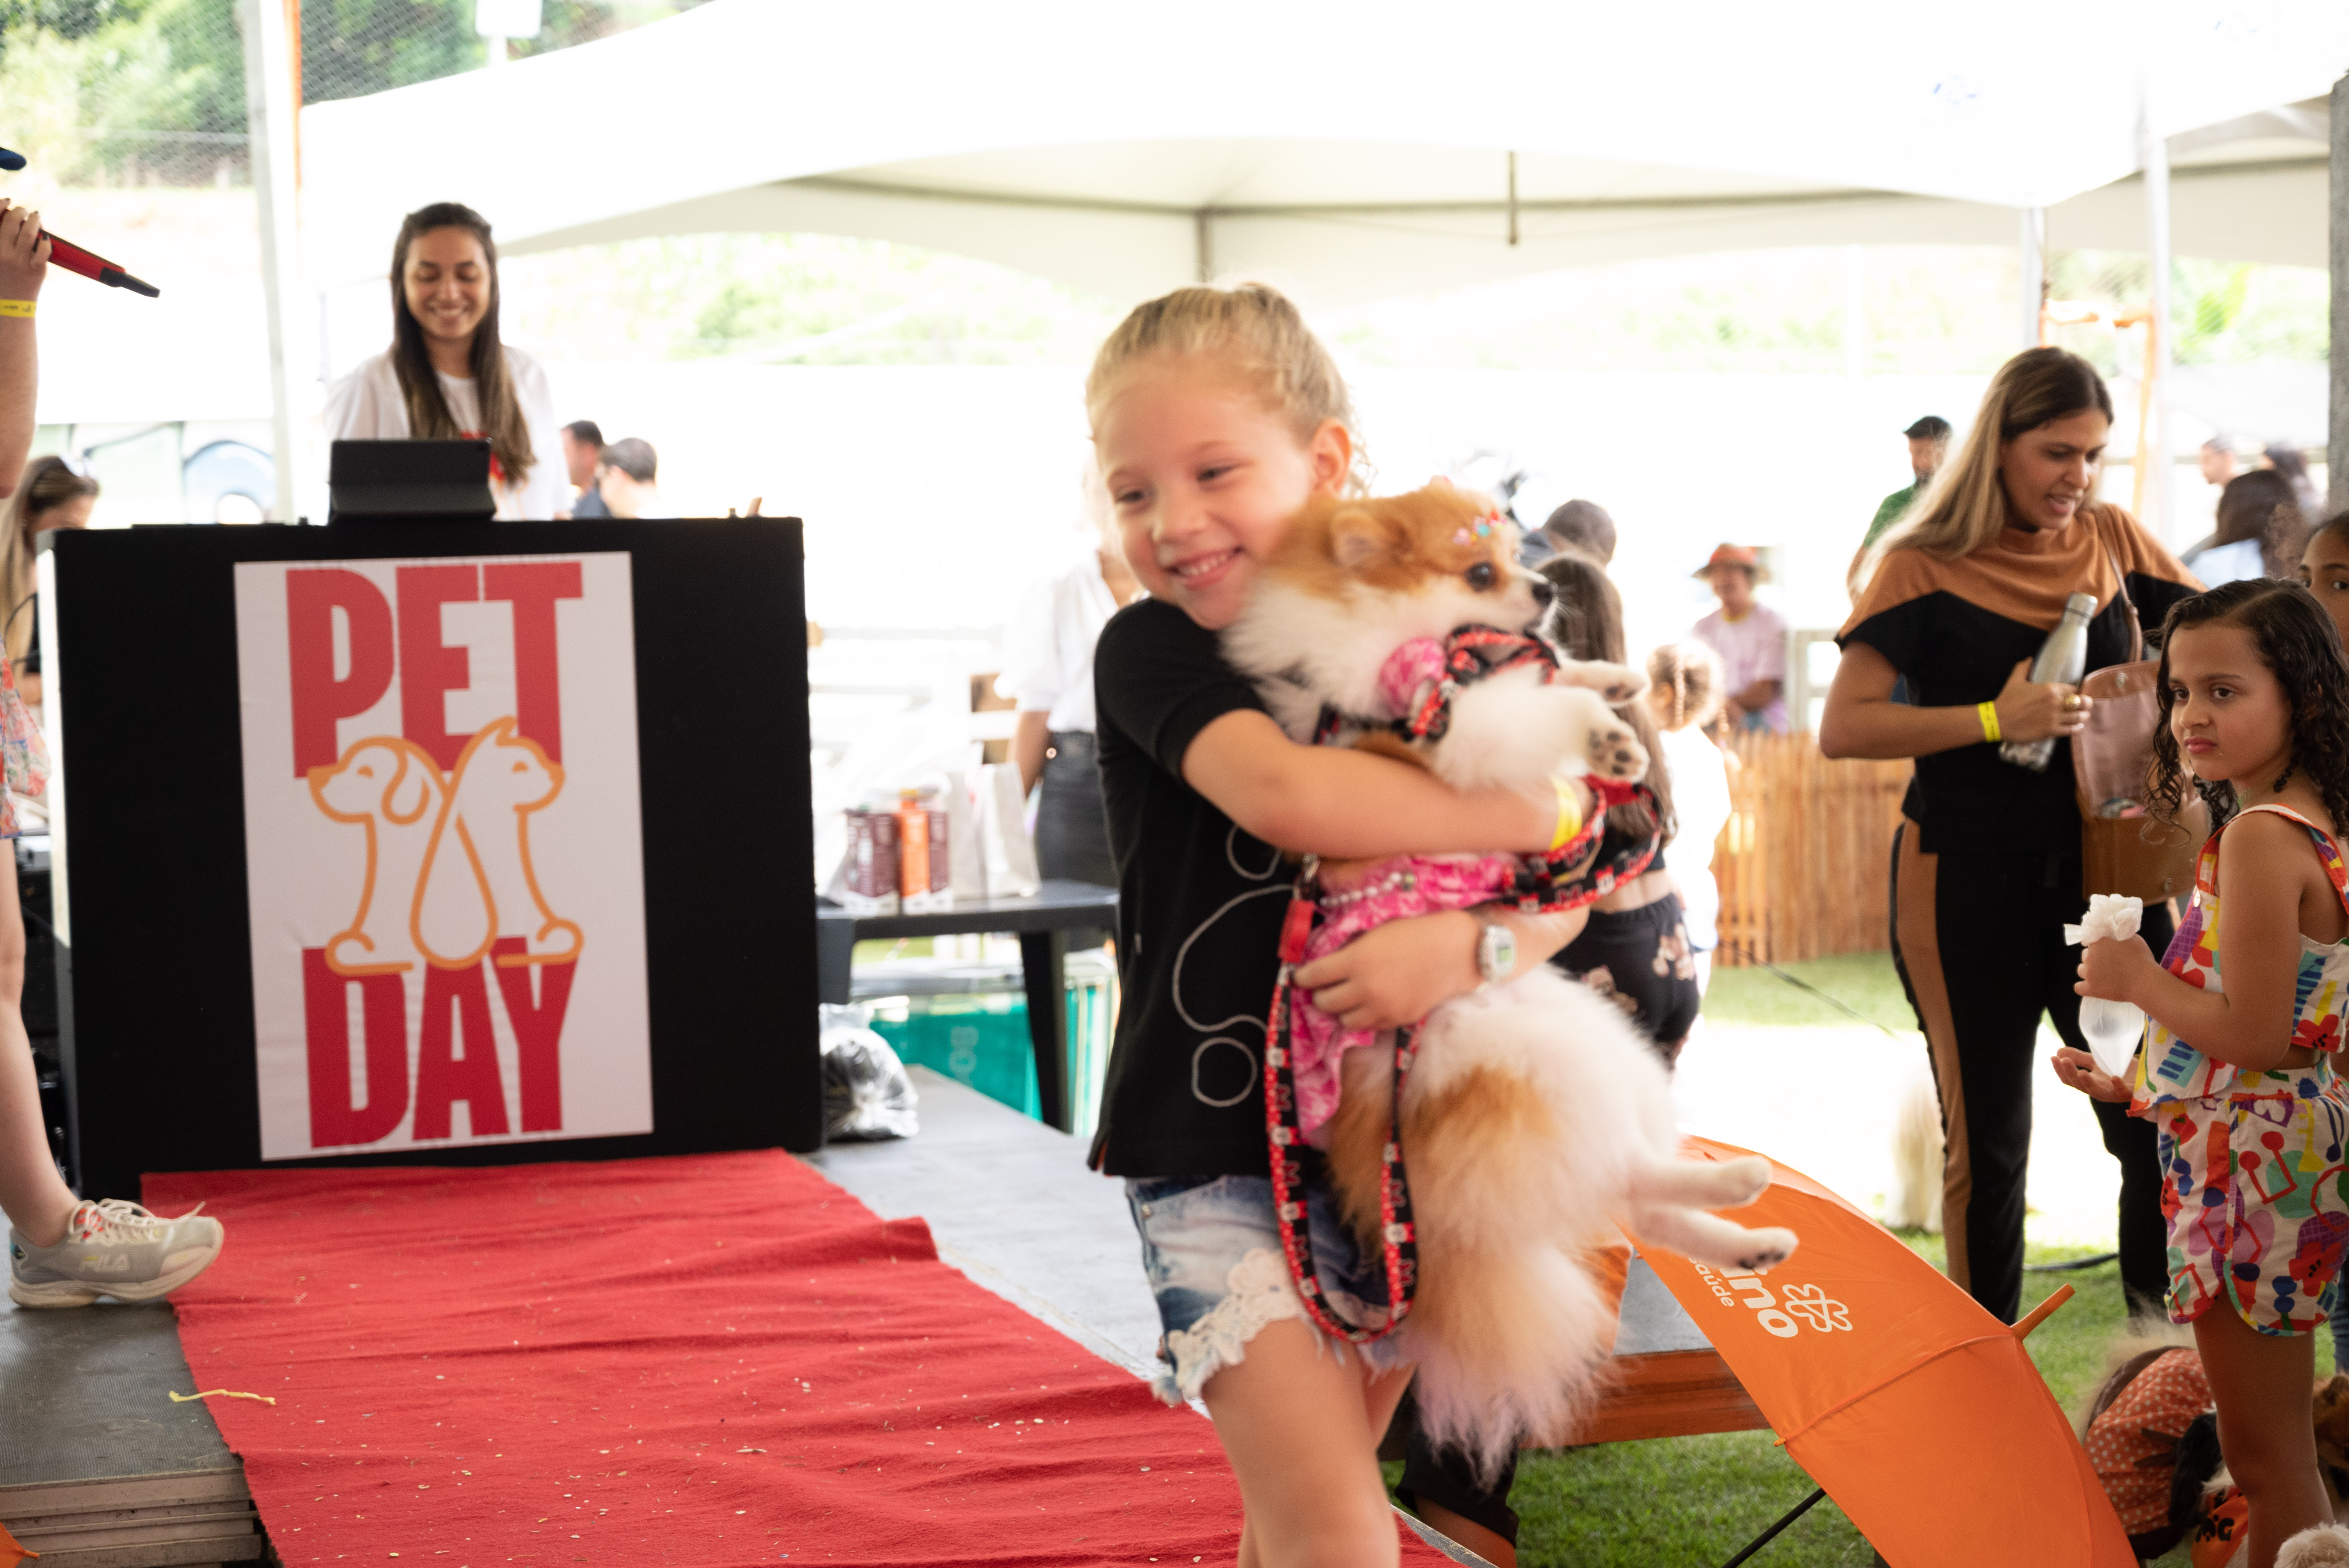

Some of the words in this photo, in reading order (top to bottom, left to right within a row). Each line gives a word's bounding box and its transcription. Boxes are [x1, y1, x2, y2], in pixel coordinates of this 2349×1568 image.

[287, 561, 583, 778] PET
[303, 937, 579, 1148] DAY
[79, 1253, 130, 1271] FILA
[1719, 1267, 1798, 1338] ino
